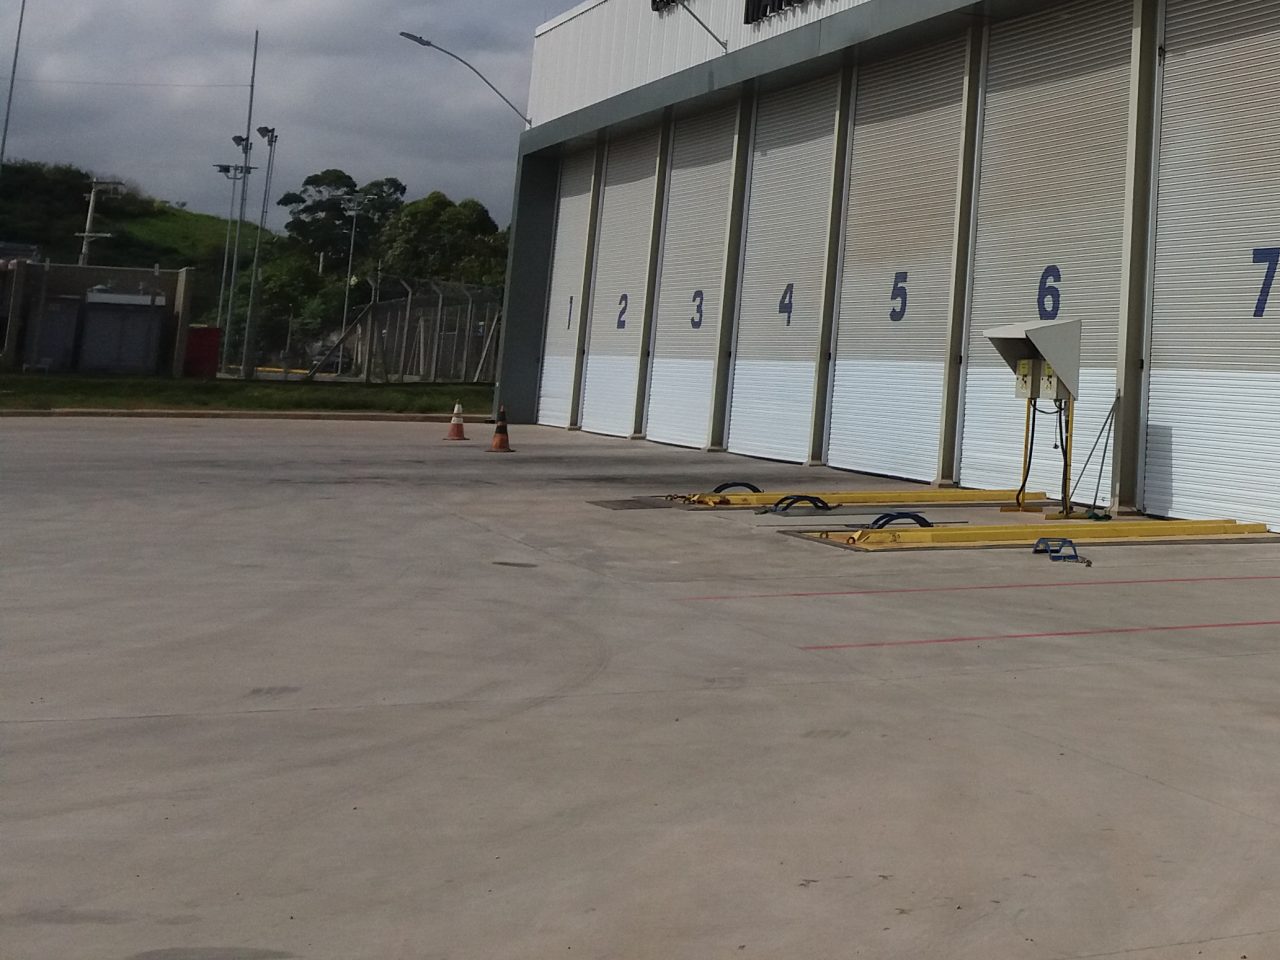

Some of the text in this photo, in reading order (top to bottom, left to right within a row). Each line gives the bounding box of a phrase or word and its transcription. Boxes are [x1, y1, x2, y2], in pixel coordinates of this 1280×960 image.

[889, 272, 909, 322] 5
[1037, 265, 1063, 320] 6
[1252, 248, 1280, 317] 7
[566, 295, 574, 330] 1
[616, 293, 629, 330] 2
[690, 290, 704, 329] 3
[778, 283, 795, 327] 4
